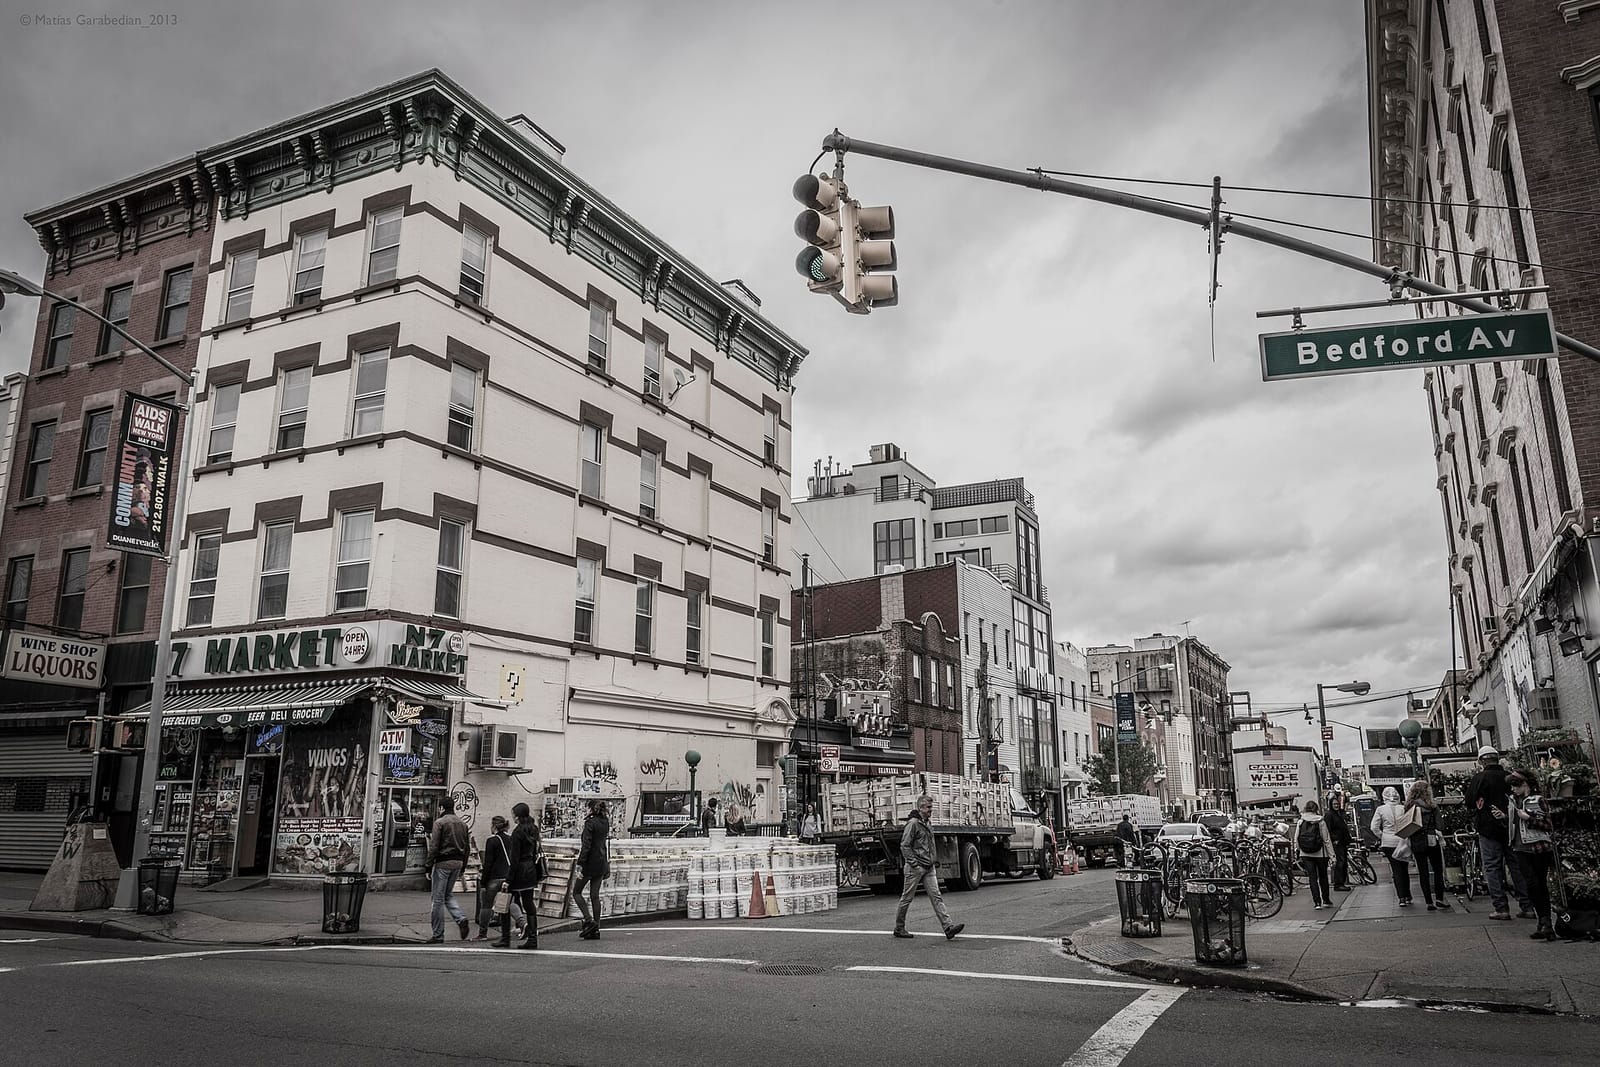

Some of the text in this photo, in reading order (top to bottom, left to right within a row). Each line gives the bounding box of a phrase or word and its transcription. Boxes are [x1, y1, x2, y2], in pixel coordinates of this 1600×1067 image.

[1297, 326, 1516, 365] Bedford Av
[136, 404, 168, 423] AIDS
[132, 428, 164, 441] NEW YORK
[134, 417, 165, 435] WALK
[138, 437, 150, 445] MAY
[115, 443, 138, 527] COMMUNITY
[152, 456, 169, 533] 212.807.WALK
[21, 637, 98, 657] WINE SHOP
[345, 633, 366, 643] OPEN
[204, 628, 342, 674] MARKET
[391, 643, 468, 674] MARKET
[11, 650, 97, 680] LIQUORS
[271, 710, 287, 721] DELI
[292, 708, 325, 720] GROCERY
[380, 730, 405, 745] ATM
[308, 748, 348, 768] WINGS
[388, 754, 420, 769] Modelo
[160, 767, 177, 776] ATM
